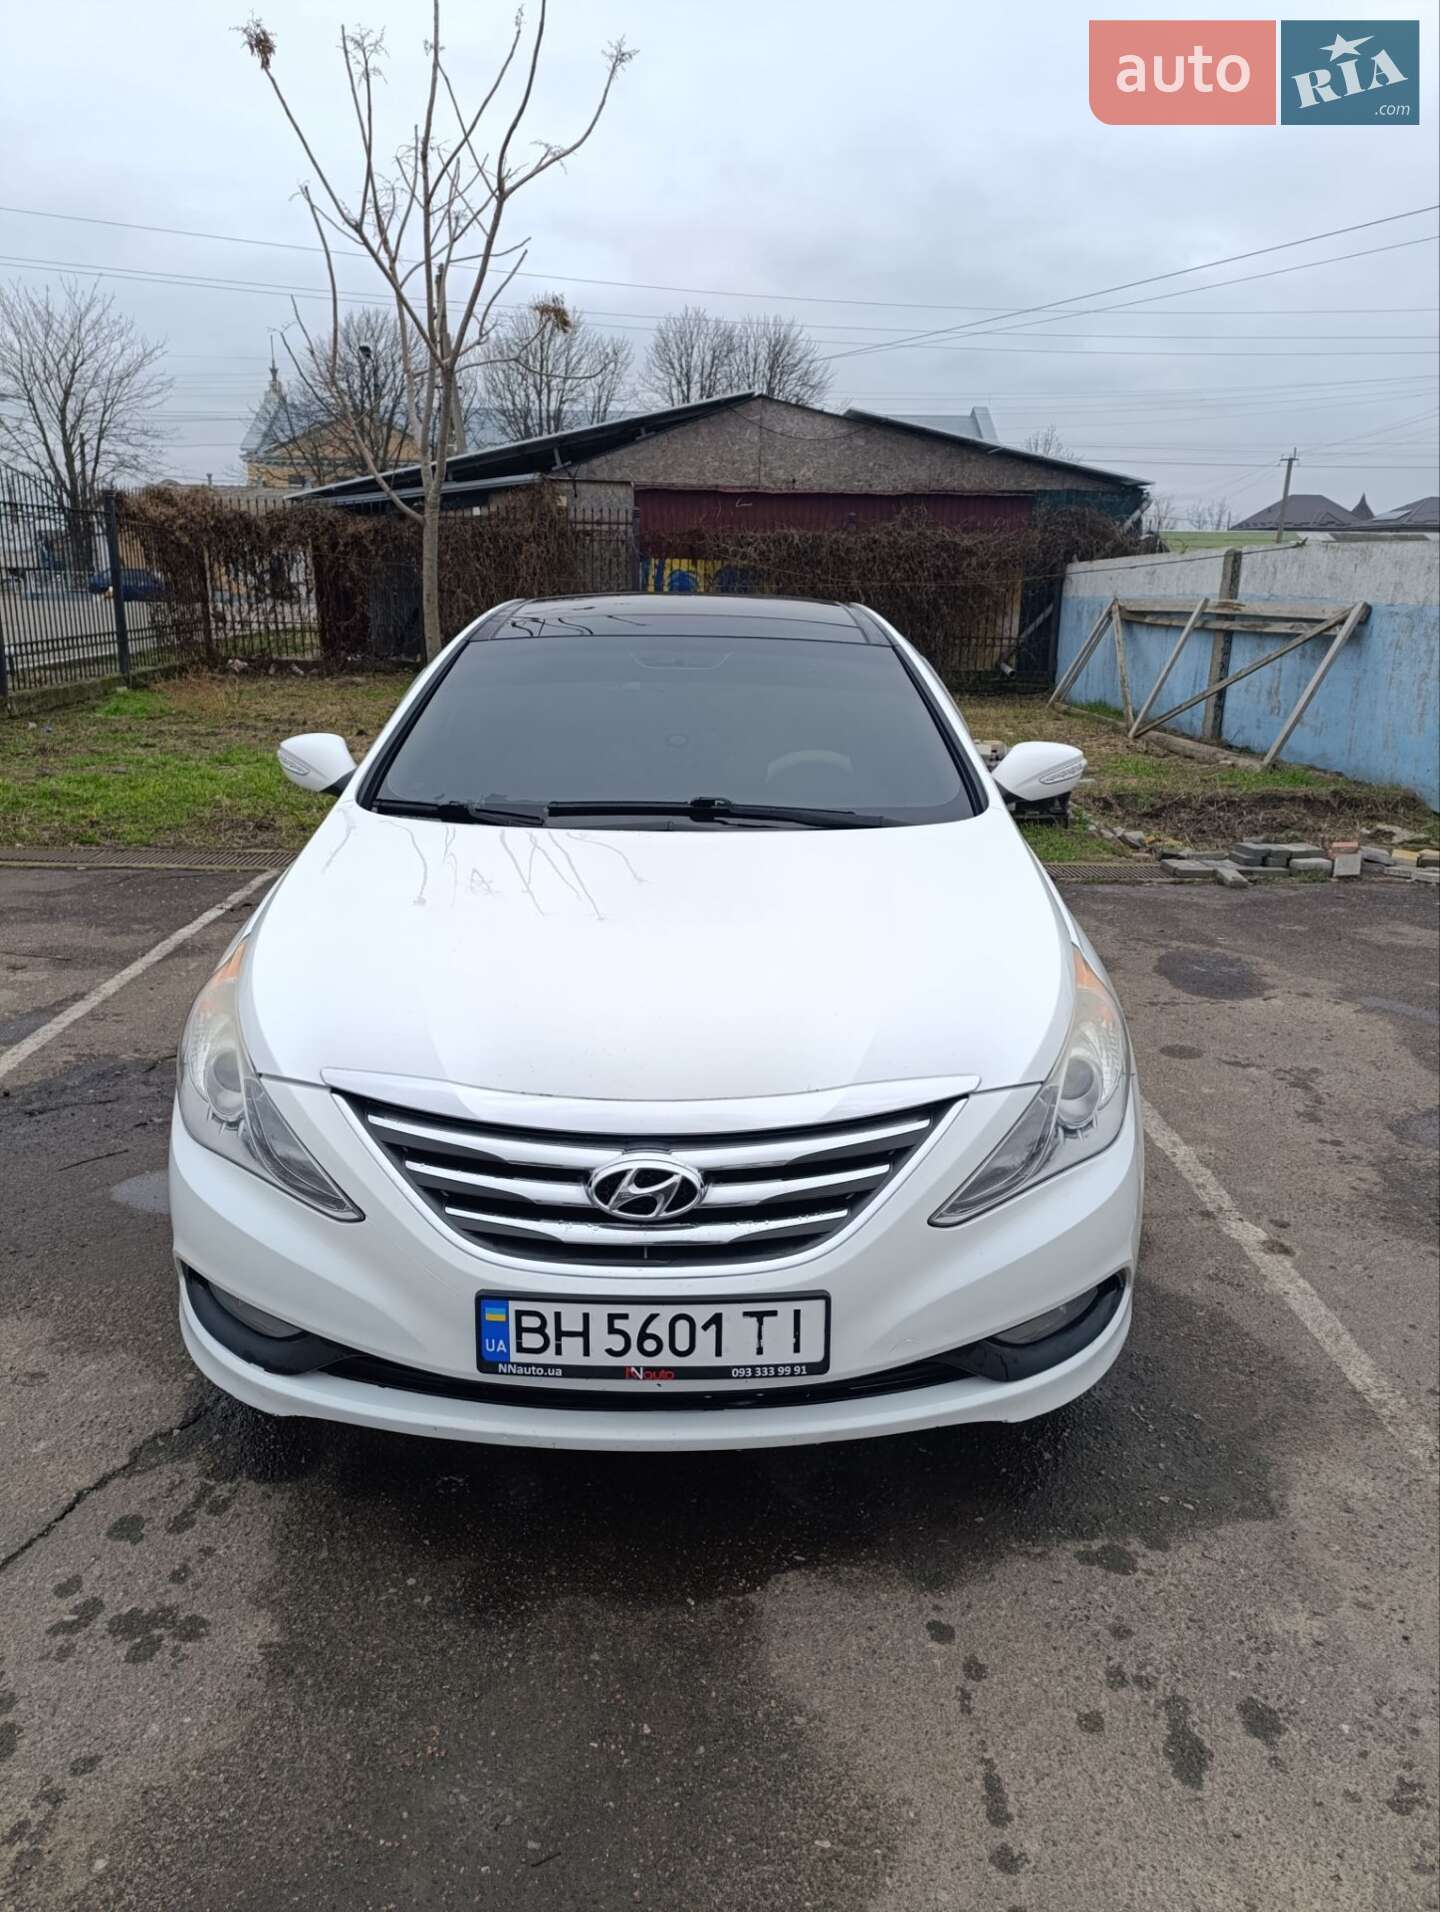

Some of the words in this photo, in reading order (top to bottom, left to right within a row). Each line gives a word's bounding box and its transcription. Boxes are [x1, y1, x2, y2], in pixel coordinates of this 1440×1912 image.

[514, 1309, 591, 1357] BH
[604, 1311, 723, 1358] 5601
[742, 1308, 801, 1356] TI
[485, 1338, 507, 1353] UA
[498, 1362, 563, 1377] NNauto.ua
[731, 1367, 752, 1378] 093
[755, 1366, 775, 1377] 333
[777, 1366, 791, 1376] 99
[793, 1365, 807, 1375] 91
